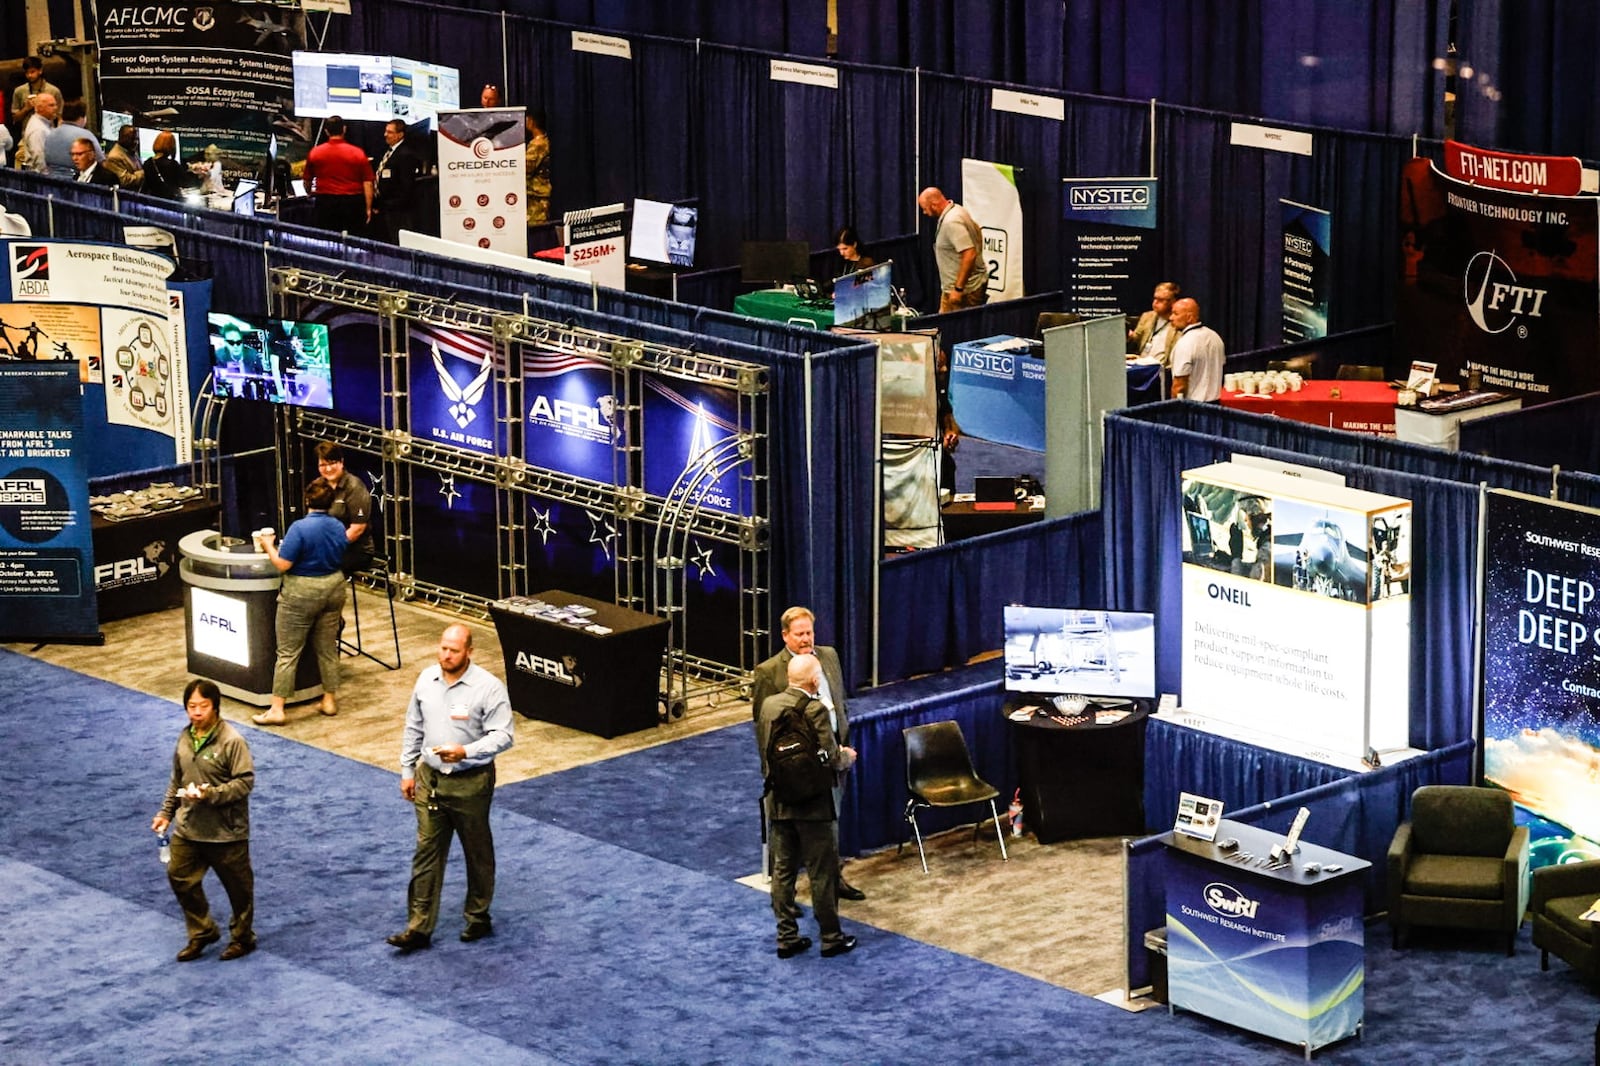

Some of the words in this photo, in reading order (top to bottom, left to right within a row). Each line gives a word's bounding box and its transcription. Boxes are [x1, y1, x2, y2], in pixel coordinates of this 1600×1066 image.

[104, 6, 188, 26] AFLCMC
[110, 55, 137, 64] Sensor
[139, 54, 160, 66] Open
[161, 54, 188, 66] System
[190, 55, 233, 66] Architecture
[238, 58, 263, 70] Systems
[126, 66, 154, 75] Enabling
[186, 86, 210, 95] SOSA
[213, 87, 255, 99] Ecosystem
[447, 159, 518, 171] CREDENCE
[1460, 151, 1548, 186] FTI-NET.COM
[1074, 188, 1147, 204] NYSTEC
[1447, 191, 1479, 214] FRONTIER
[1480, 203, 1544, 223] TECHNOLOGY
[1546, 211, 1570, 225] INC.
[573, 229, 597, 240] FEDERAL
[597, 225, 622, 237] FUNDING
[1077, 235, 1115, 243] Independent,
[1115, 234, 1142, 243] nonprofit
[573, 244, 617, 261] $256M+
[984, 237, 1004, 253] MILE
[1081, 243, 1112, 251] technology
[1113, 243, 1139, 251] company
[1284, 236, 1312, 253] NYSTEC
[66, 249, 111, 260] Aerospace
[988, 259, 1000, 281] 2
[19, 280, 50, 295] ABDA
[1488, 282, 1548, 317] FTI
[954, 350, 1013, 373] NYSTEC
[1499, 367, 1518, 380] WORLD
[1482, 374, 1514, 388] PRODUCTIVE
[1514, 381, 1527, 390] AND
[1527, 382, 1550, 393] SECURE
[529, 395, 611, 434] AFRL
[46, 431, 73, 439] TALKS
[1343, 421, 1369, 431] MAKING
[1369, 422, 1381, 431] THE
[1, 440, 24, 448] FROM
[25, 440, 54, 448] AFRL'S
[432, 427, 449, 439] U.S.
[450, 431, 465, 442] AIR
[466, 434, 493, 449] FORCE
[27, 449, 71, 457] BRIGHTEST
[1526, 531, 1580, 553] SOUTHWEST
[1207, 583, 1252, 608] ONEIL
[1526, 568, 1595, 615] DEEP
[199, 612, 237, 634] AFRL
[1518, 609, 1588, 656] DEEP
[1194, 620, 1240, 644] Delivering
[1241, 634, 1329, 664] mil-spec-compliant
[515, 651, 574, 681] AFRL
[1194, 638, 1229, 656] product
[1231, 648, 1265, 664] support
[1267, 655, 1322, 679] information
[1323, 671, 1334, 681] to
[1194, 653, 1223, 670] reduce
[1225, 662, 1273, 682] equipment
[1275, 673, 1303, 690] whole
[1304, 681, 1320, 694] life
[1320, 687, 1348, 701] costs.
[1208, 888, 1260, 919] SwRI
[1181, 904, 1219, 924] SOUTHWEST
[1219, 917, 1251, 935] RESEARCH
[1252, 927, 1286, 943] INSTITUTE
